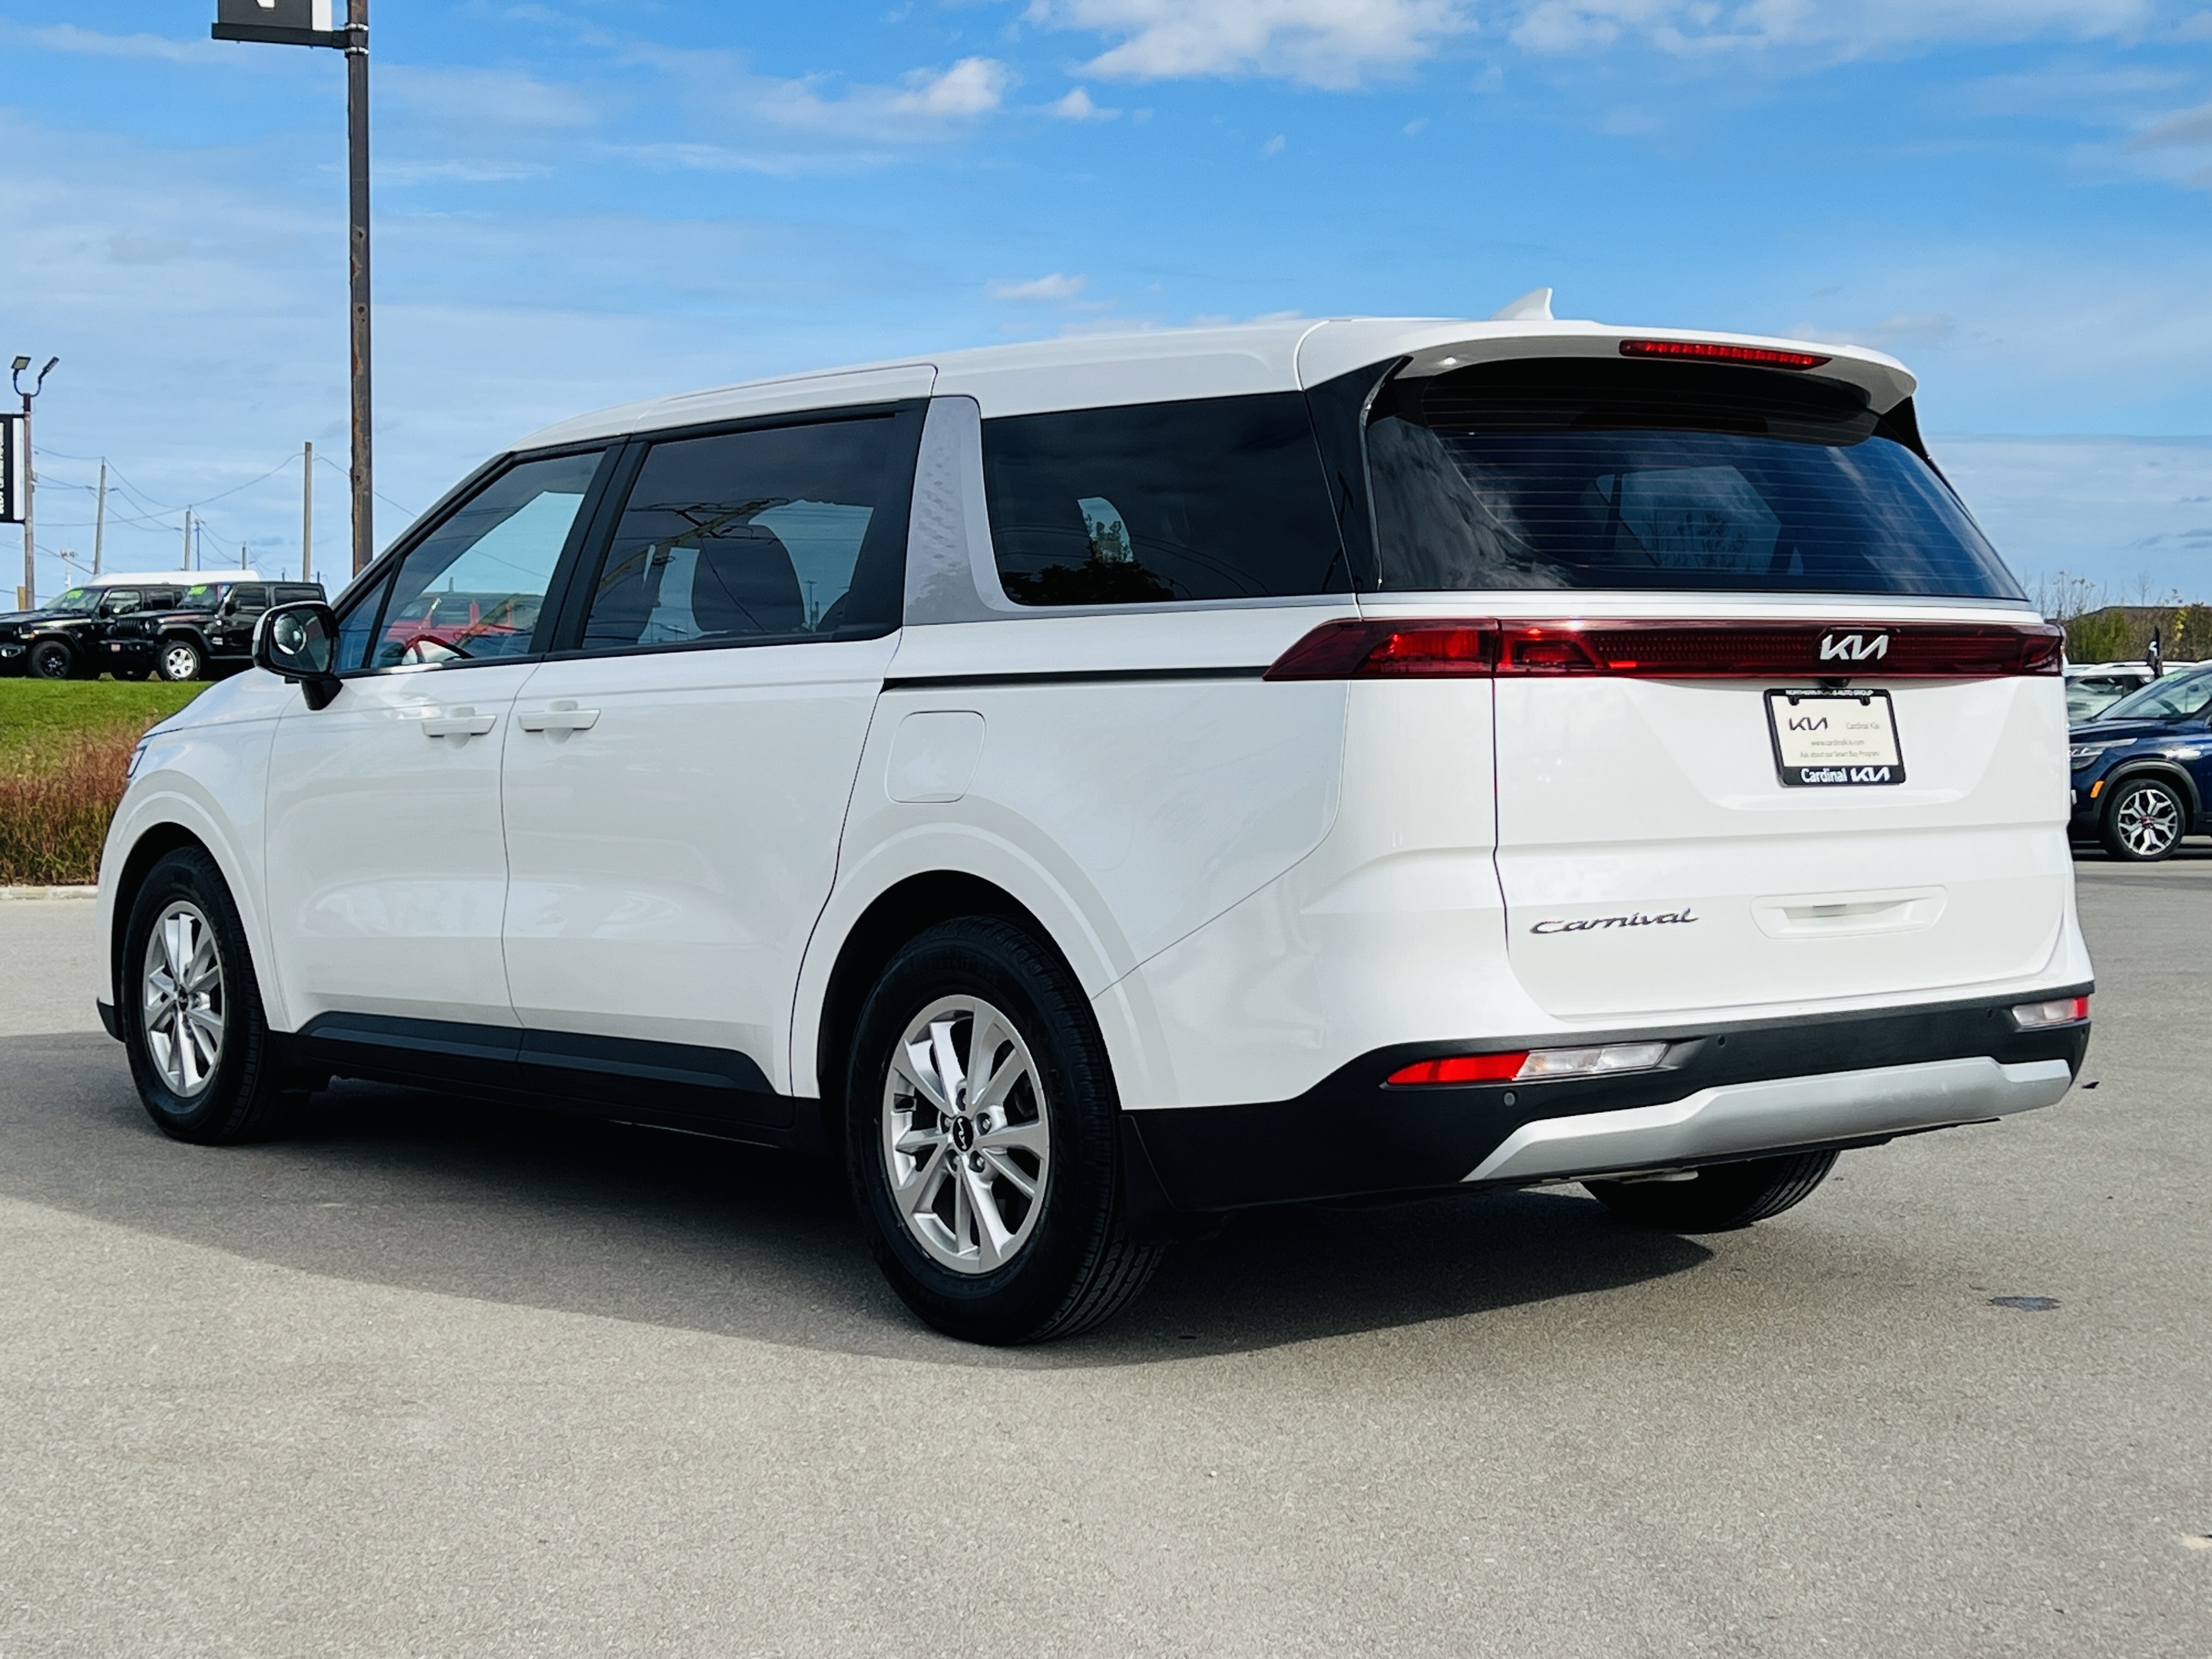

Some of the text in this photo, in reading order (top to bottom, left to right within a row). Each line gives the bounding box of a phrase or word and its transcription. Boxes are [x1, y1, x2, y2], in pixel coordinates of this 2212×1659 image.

[1820, 634, 1889, 660] KIA
[1788, 717, 1828, 730] KIA
[1800, 767, 1890, 783] Cardinal KIA
[1530, 908, 1700, 934] Carnival
